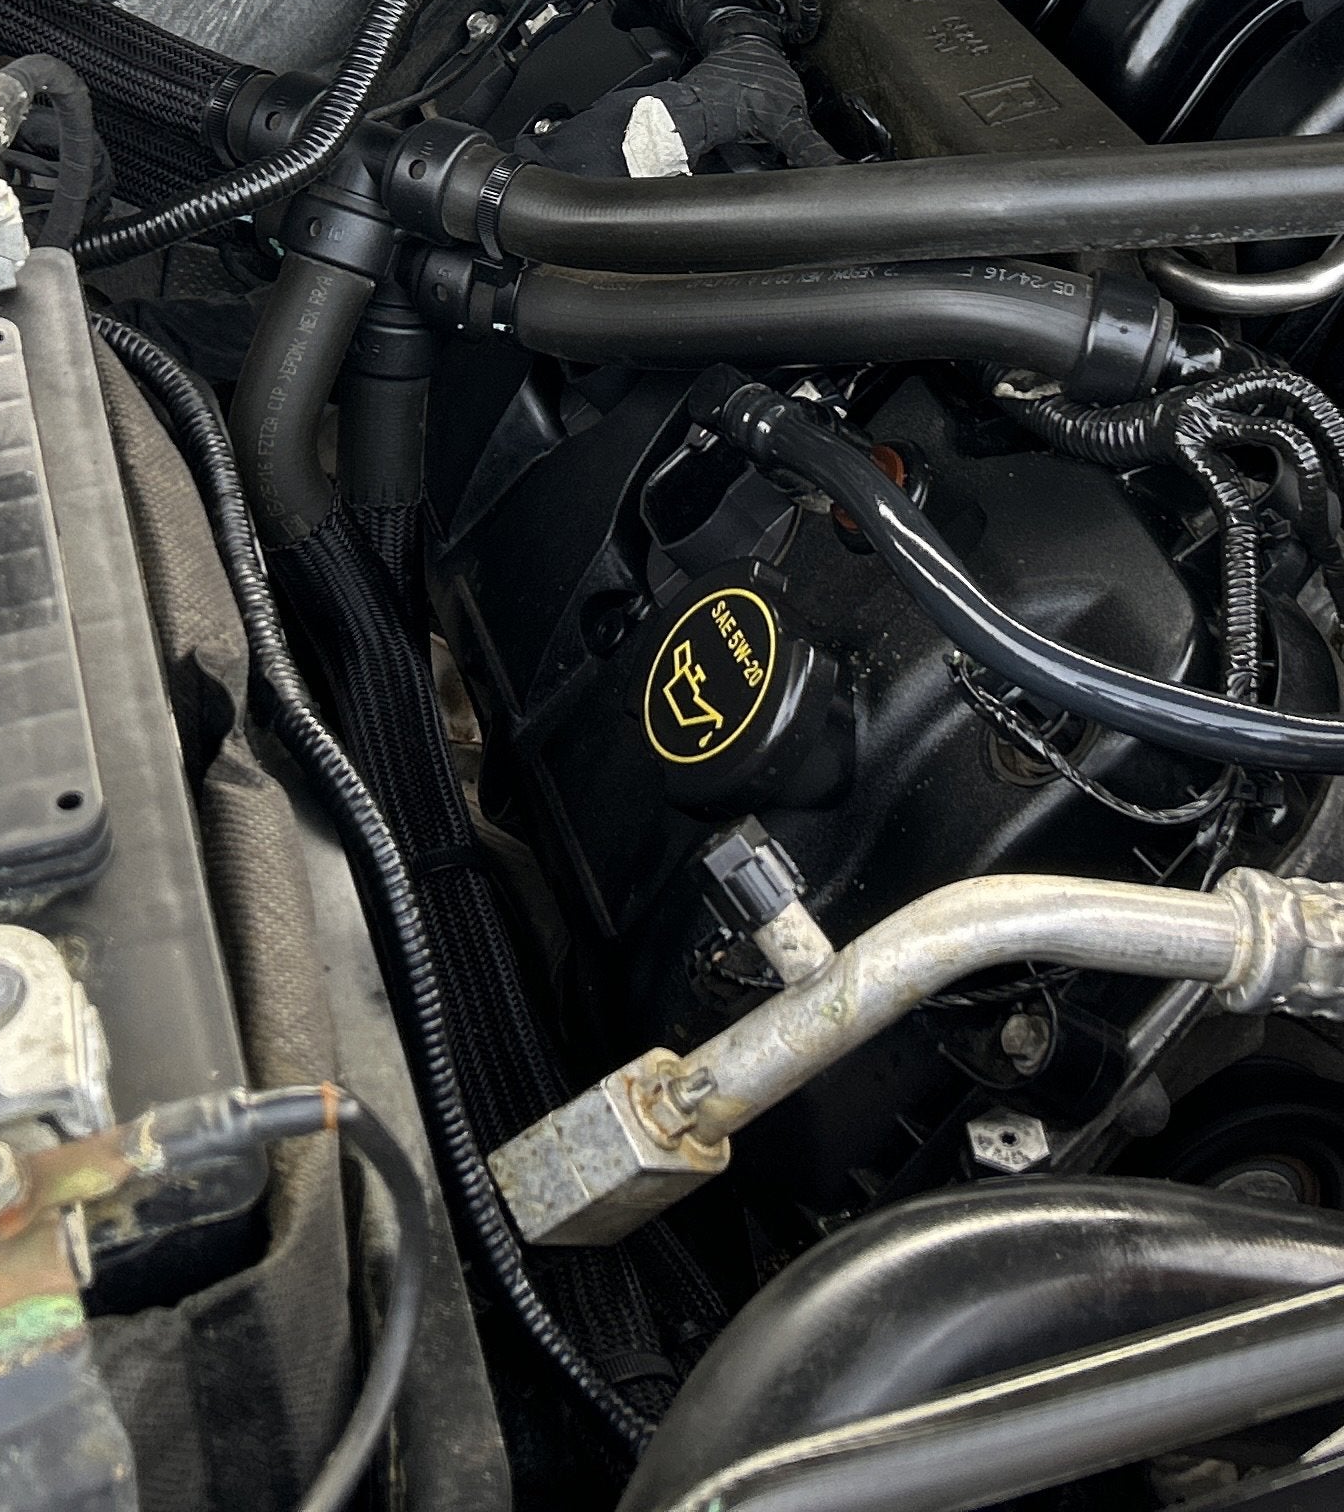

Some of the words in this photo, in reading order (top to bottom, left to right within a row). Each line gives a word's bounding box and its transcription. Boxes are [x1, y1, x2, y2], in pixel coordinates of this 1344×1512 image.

[982, 266, 1076, 297] 05/24/16
[711, 599, 737, 639] SAE
[728, 629, 764, 688] 5W-20
